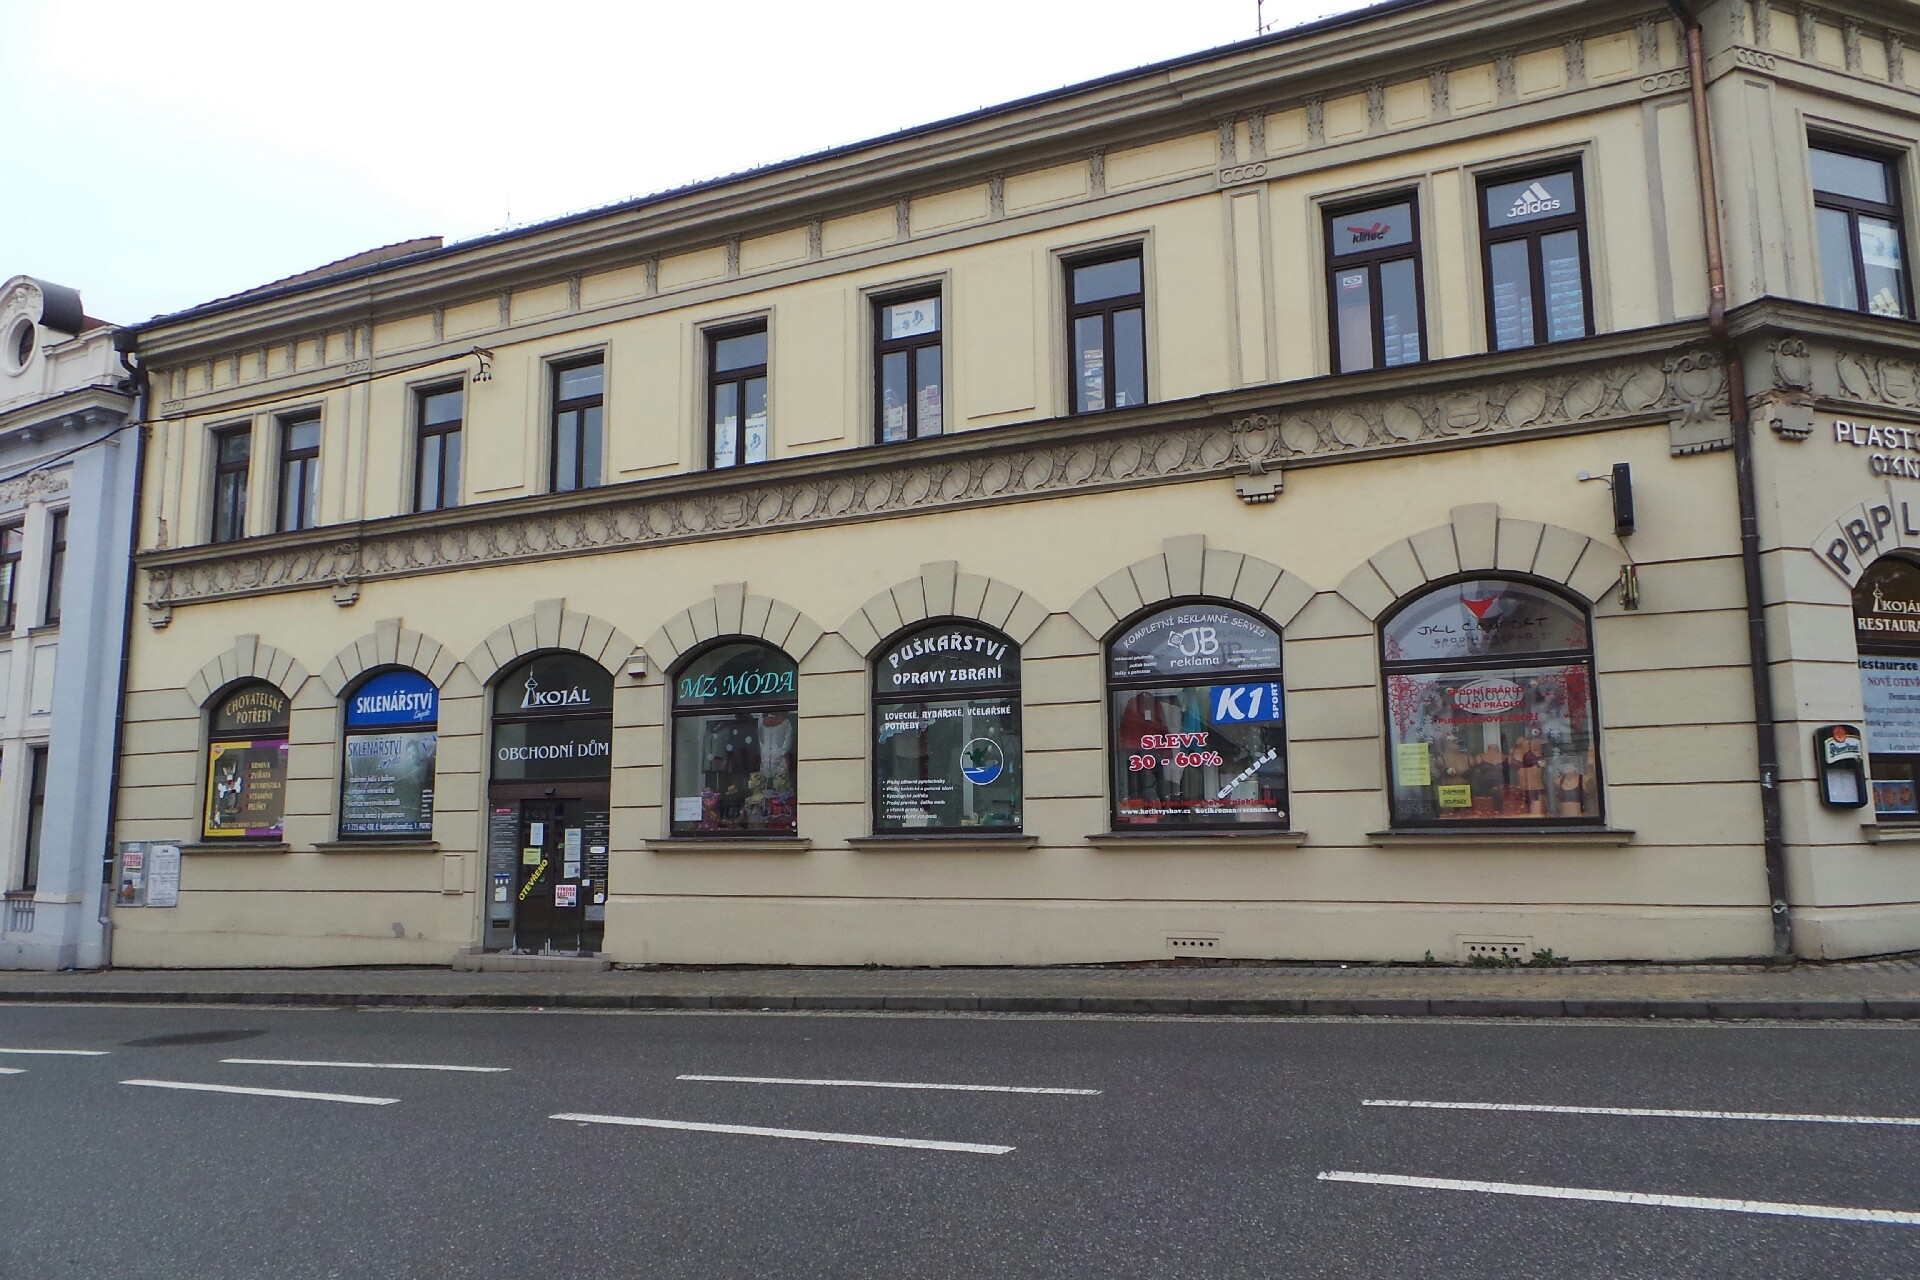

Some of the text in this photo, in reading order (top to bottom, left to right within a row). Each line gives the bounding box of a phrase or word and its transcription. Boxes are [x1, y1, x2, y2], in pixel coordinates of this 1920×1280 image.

[1833, 419, 1920, 451] PLAST
[1123, 613, 1266, 648] KOMPLETNÍ REKLAMNÍ SERVIS
[1180, 627, 1219, 656] JB
[888, 632, 1008, 669] PUŠKAŘSTVÍ
[1170, 656, 1219, 667] reklama
[680, 668, 795, 699] MZ MÓDA
[893, 664, 1002, 685] OPRAVY ZBRANÍ
[226, 692, 284, 716] CHOVATELSKÉ
[356, 688, 433, 714] SKLENÁŘSTVÍ
[534, 686, 591, 706] KOJÁL
[1216, 687, 1263, 721] K1
[1271, 682, 1279, 719] SPORT
[236, 707, 272, 724] POTŘEBY
[885, 705, 1011, 720] LOVECKÉ, RYBÁŘSKÉ, VČELAŘSKÉ
[885, 721, 919, 730] POTŘEBY
[348, 736, 402, 757] SKLENÁŘSTVÍ
[498, 739, 609, 761] OBCHODNÍ DŮM
[1140, 732, 1209, 749] SLEVY
[1129, 754, 1156, 771] 30
[1176, 751, 1223, 768] 60%
[518, 859, 548, 900] OTEVŘENO
